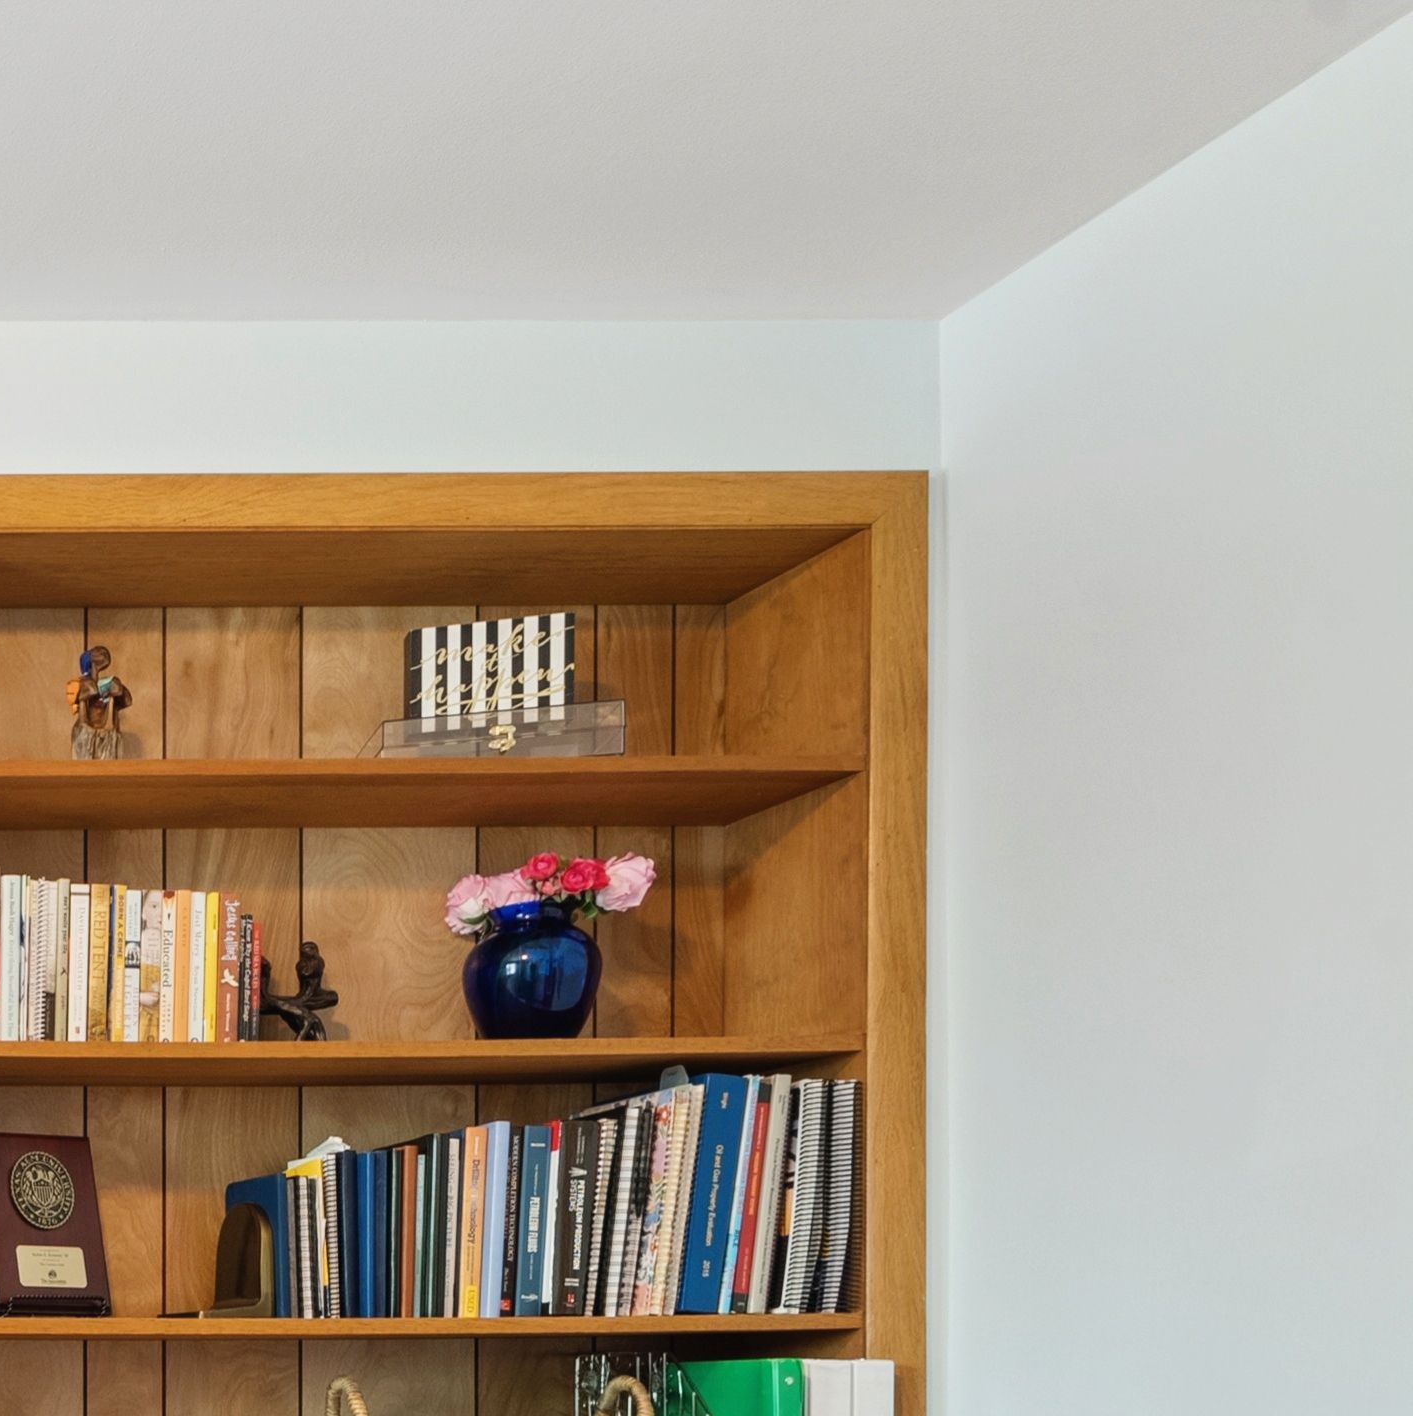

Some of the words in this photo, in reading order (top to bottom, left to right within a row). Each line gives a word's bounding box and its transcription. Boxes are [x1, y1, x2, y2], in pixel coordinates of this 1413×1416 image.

[410, 623, 575, 670] make
[409, 662, 575, 715] happen
[92, 911, 106, 938] RED
[224, 899, 240, 928] Jesus
[92, 943, 106, 983] TENT
[161, 929, 173, 987] Educated
[510, 1135, 520, 1165] MODERN
[713, 1156, 723, 1168] and
[714, 1145, 724, 1155] Oil
[508, 1168, 519, 1213] COMPLETION
[711, 1169, 721, 1182] Gas
[568, 1179, 578, 1212] SYSTEMS
[574, 1179, 585, 1223] PETROLEUM
[706, 1184, 720, 1212] Property
[527, 1197, 540, 1230] PETROLEUM
[704, 1212, 717, 1246] Evaluation
[505, 1214, 517, 1262] TECHNOLOGY
[526, 1232, 537, 1253] FLUIDS
[572, 1225, 583, 1270] PRODUCTION
[701, 1259, 711, 1277] 2015
[465, 1290, 475, 1313] USED
